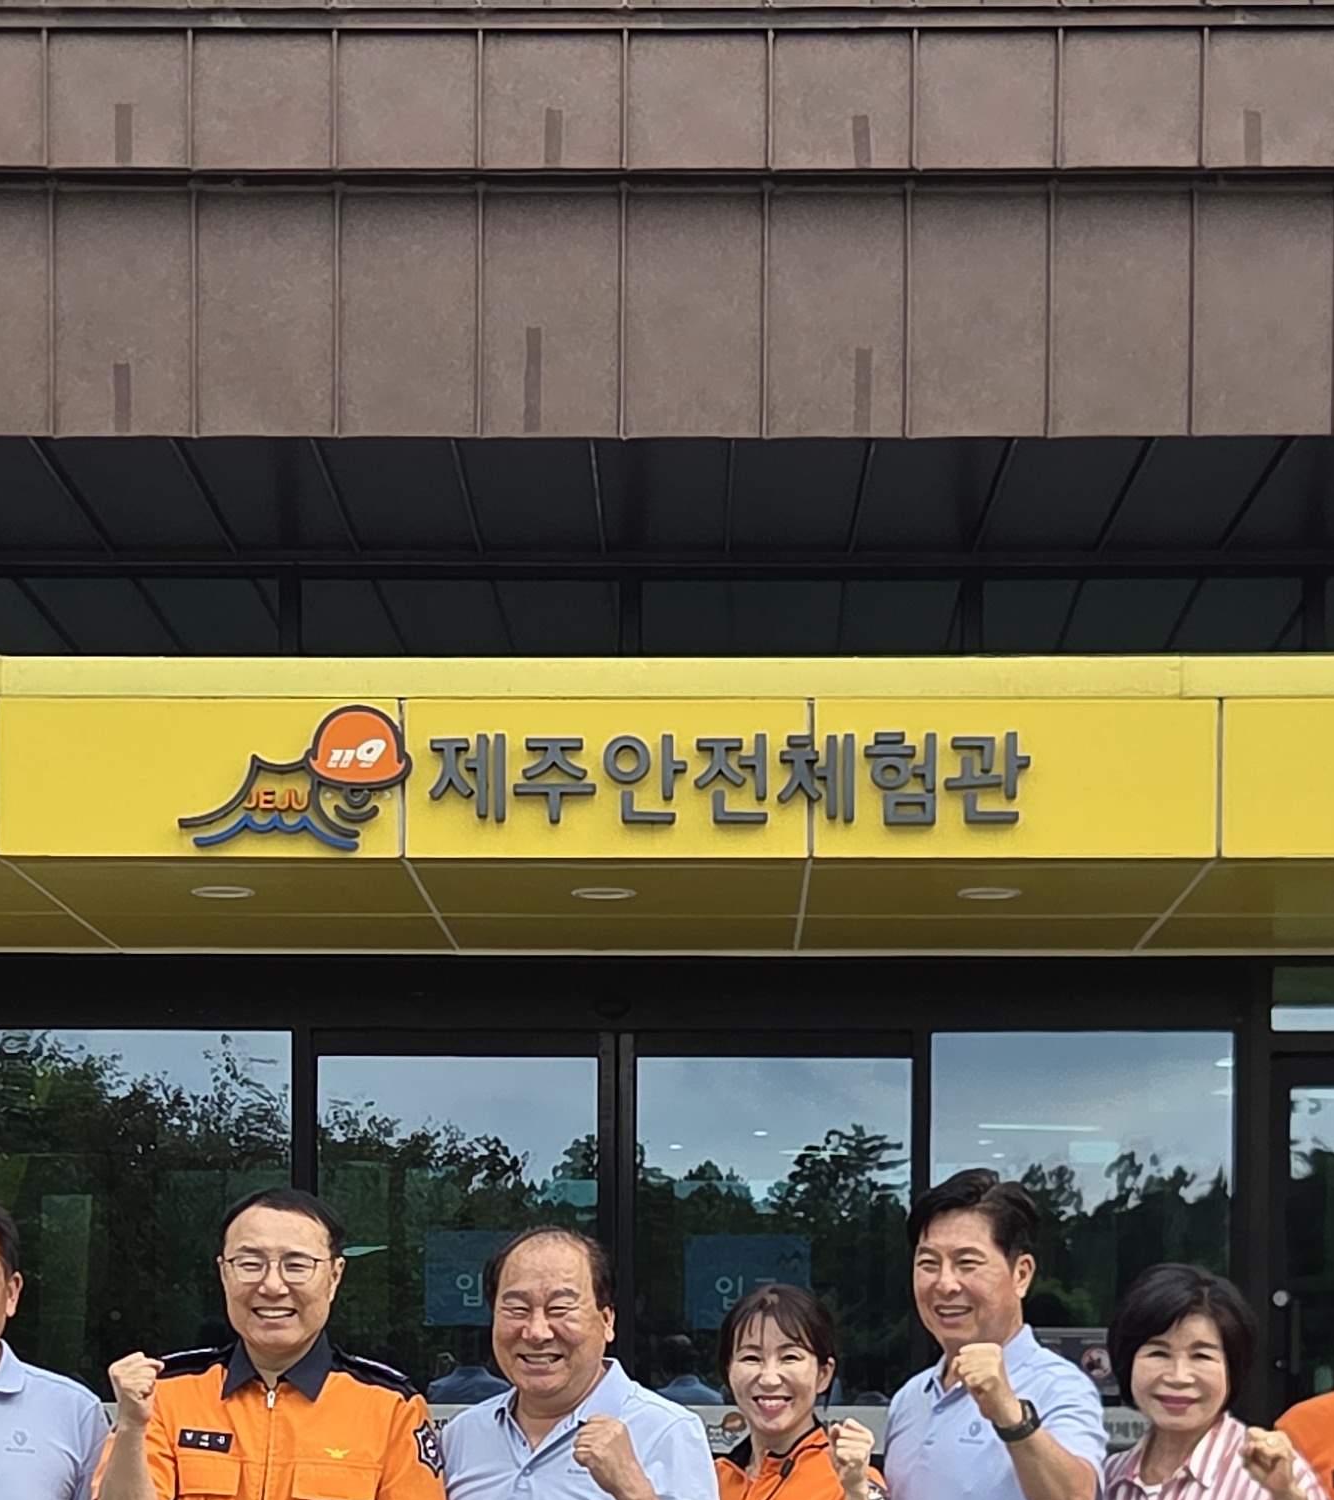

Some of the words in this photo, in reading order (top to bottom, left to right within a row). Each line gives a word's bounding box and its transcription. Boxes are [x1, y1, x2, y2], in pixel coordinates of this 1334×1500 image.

[326, 737, 387, 769] 119
[428, 729, 1032, 828] 제주안전체험관
[242, 786, 311, 812] JEJU
[455, 1272, 484, 1307] 입
